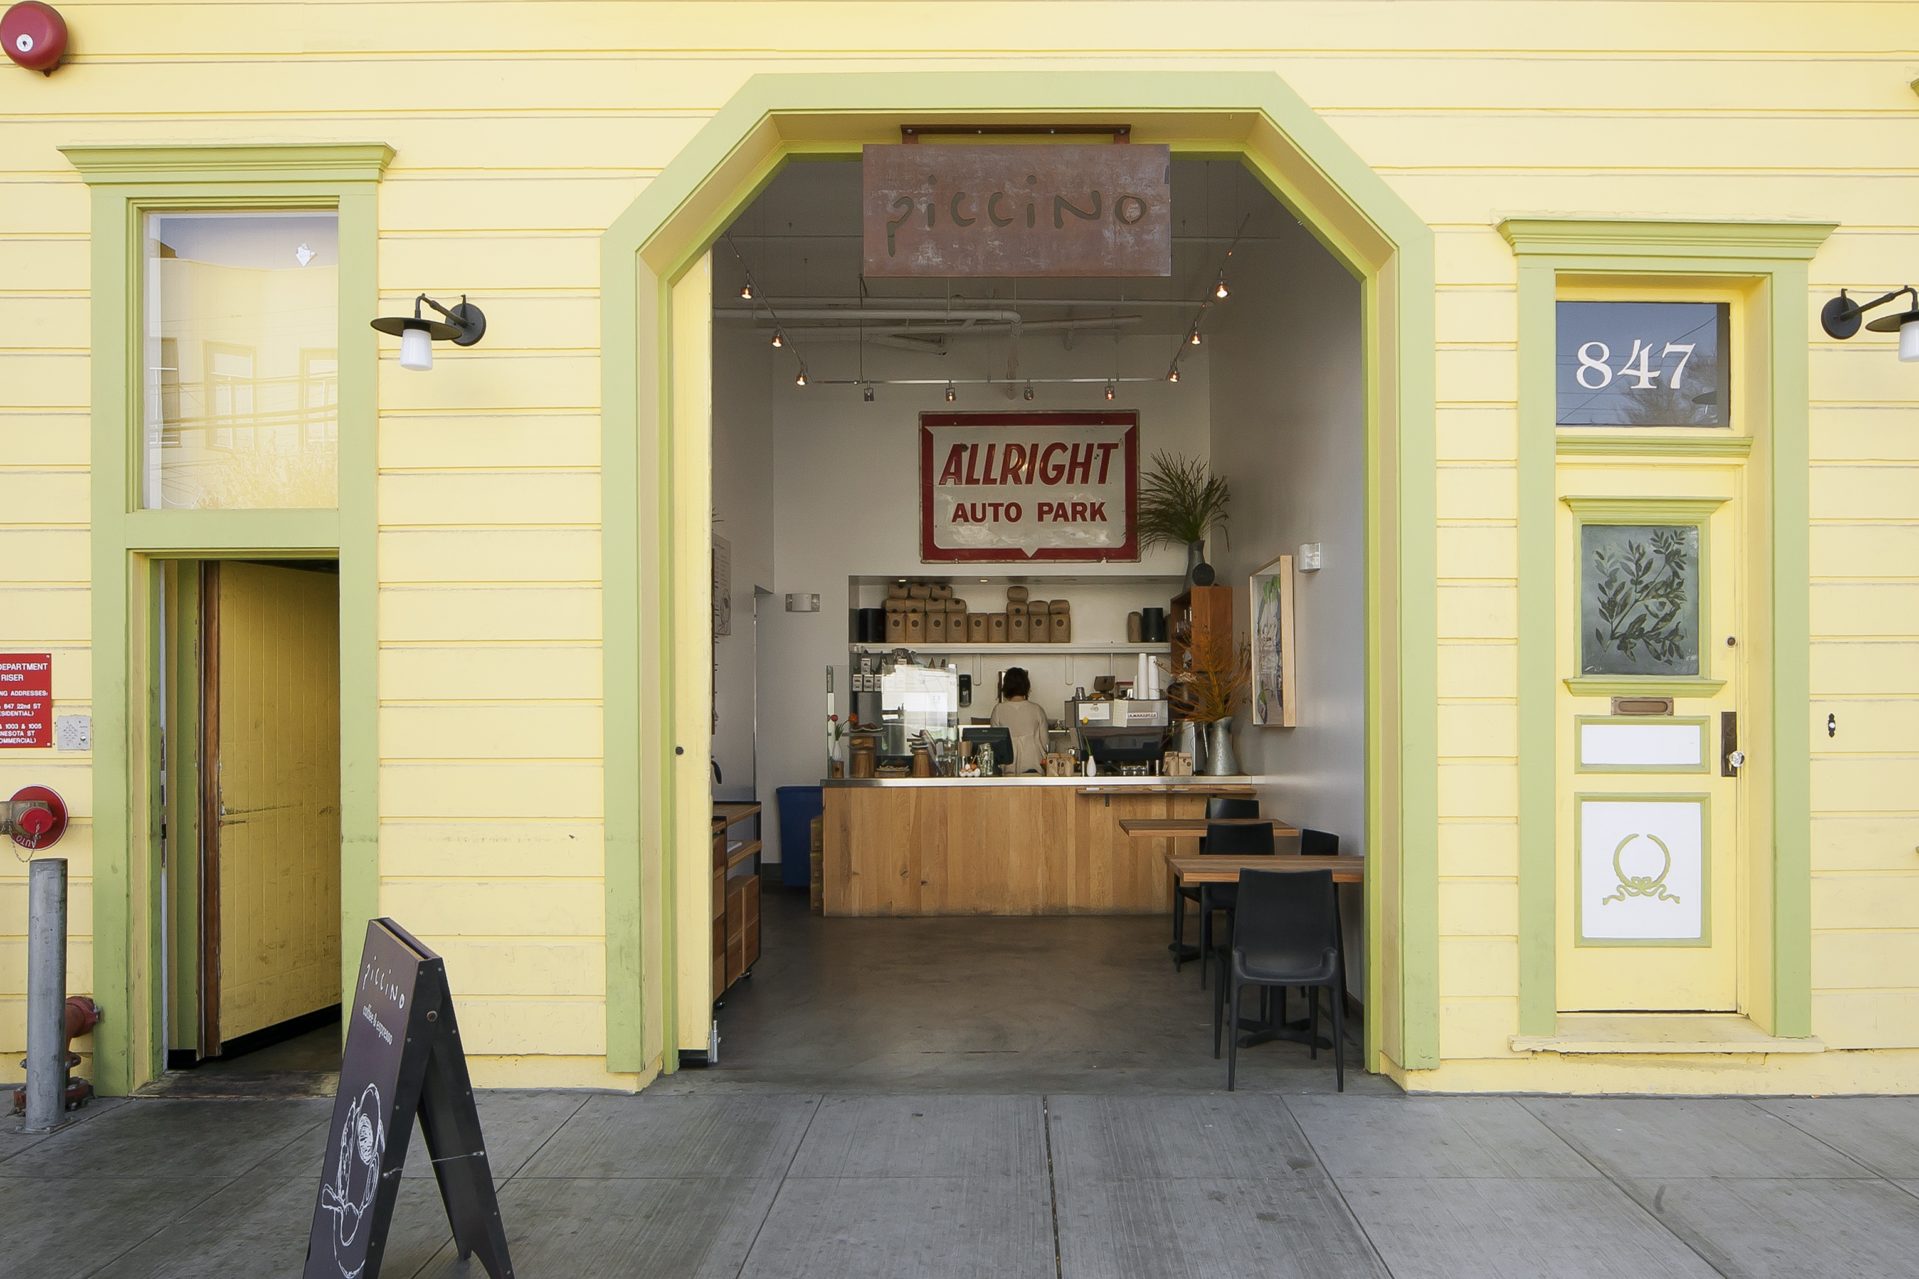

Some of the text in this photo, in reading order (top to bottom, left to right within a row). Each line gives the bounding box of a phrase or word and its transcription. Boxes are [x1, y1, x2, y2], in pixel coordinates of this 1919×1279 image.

[1576, 339, 1696, 390] 847
[938, 442, 1119, 486] ALLRIGHT
[951, 502, 1108, 523] AUTO PARK
[362, 1003, 374, 1024] coffee
[376, 1020, 393, 1046] espresso
